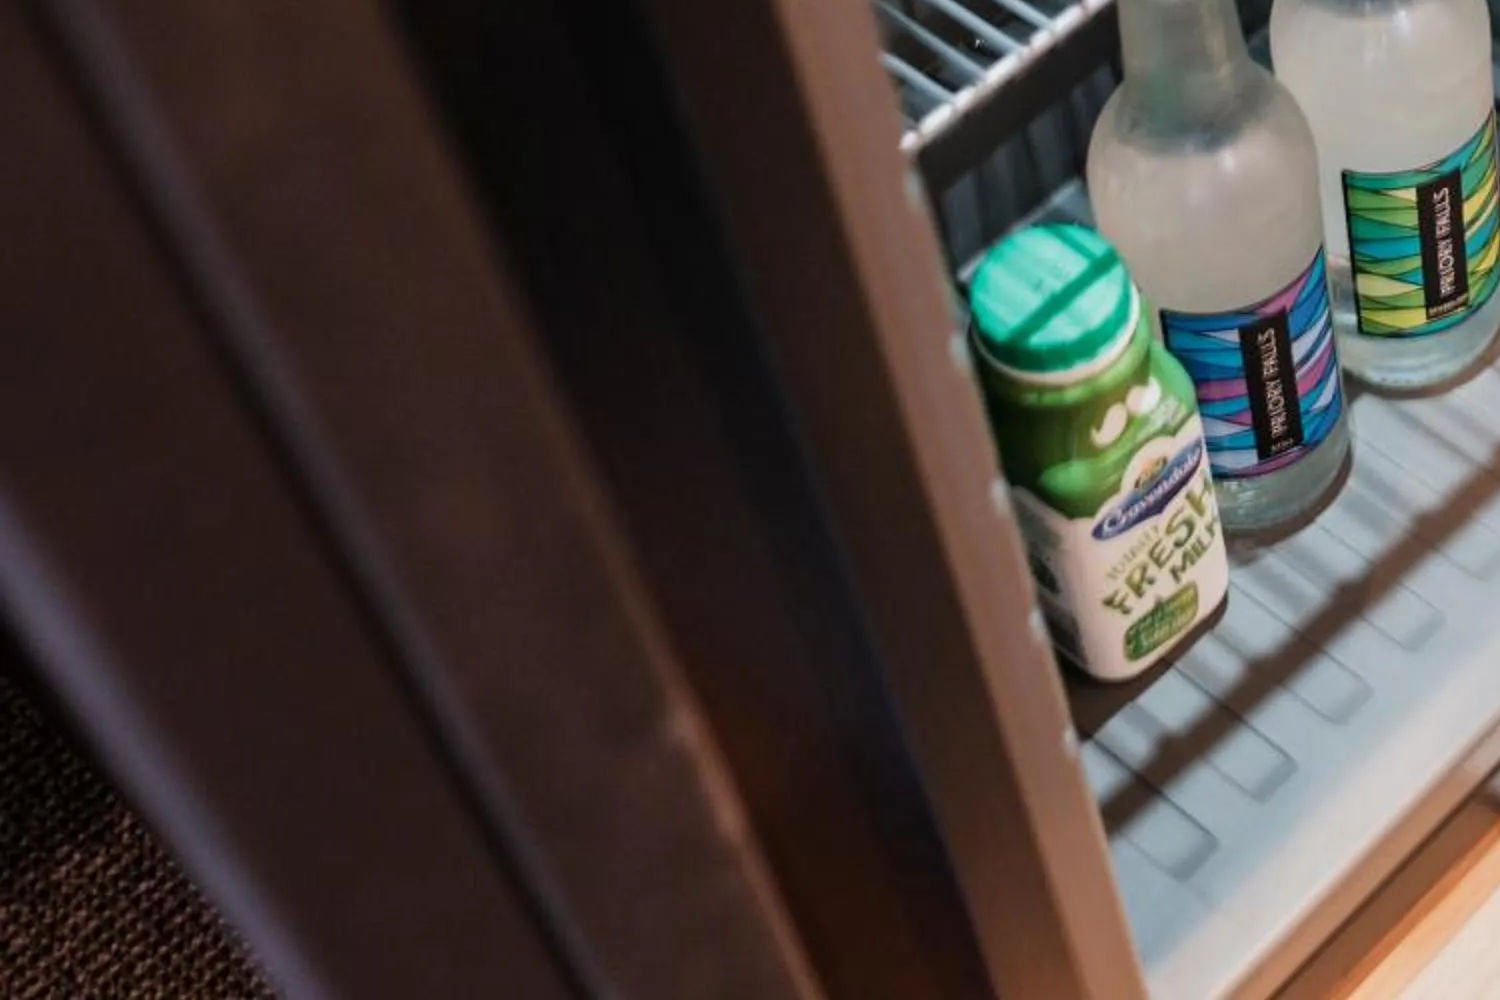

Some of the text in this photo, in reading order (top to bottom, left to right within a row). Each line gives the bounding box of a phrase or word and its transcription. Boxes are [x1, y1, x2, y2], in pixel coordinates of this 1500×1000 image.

[1433, 187, 1451, 238] FALLS
[1436, 239, 1456, 298] PRIORY
[1257, 327, 1279, 378] FALLS
[1265, 379, 1288, 437] PRIORY
